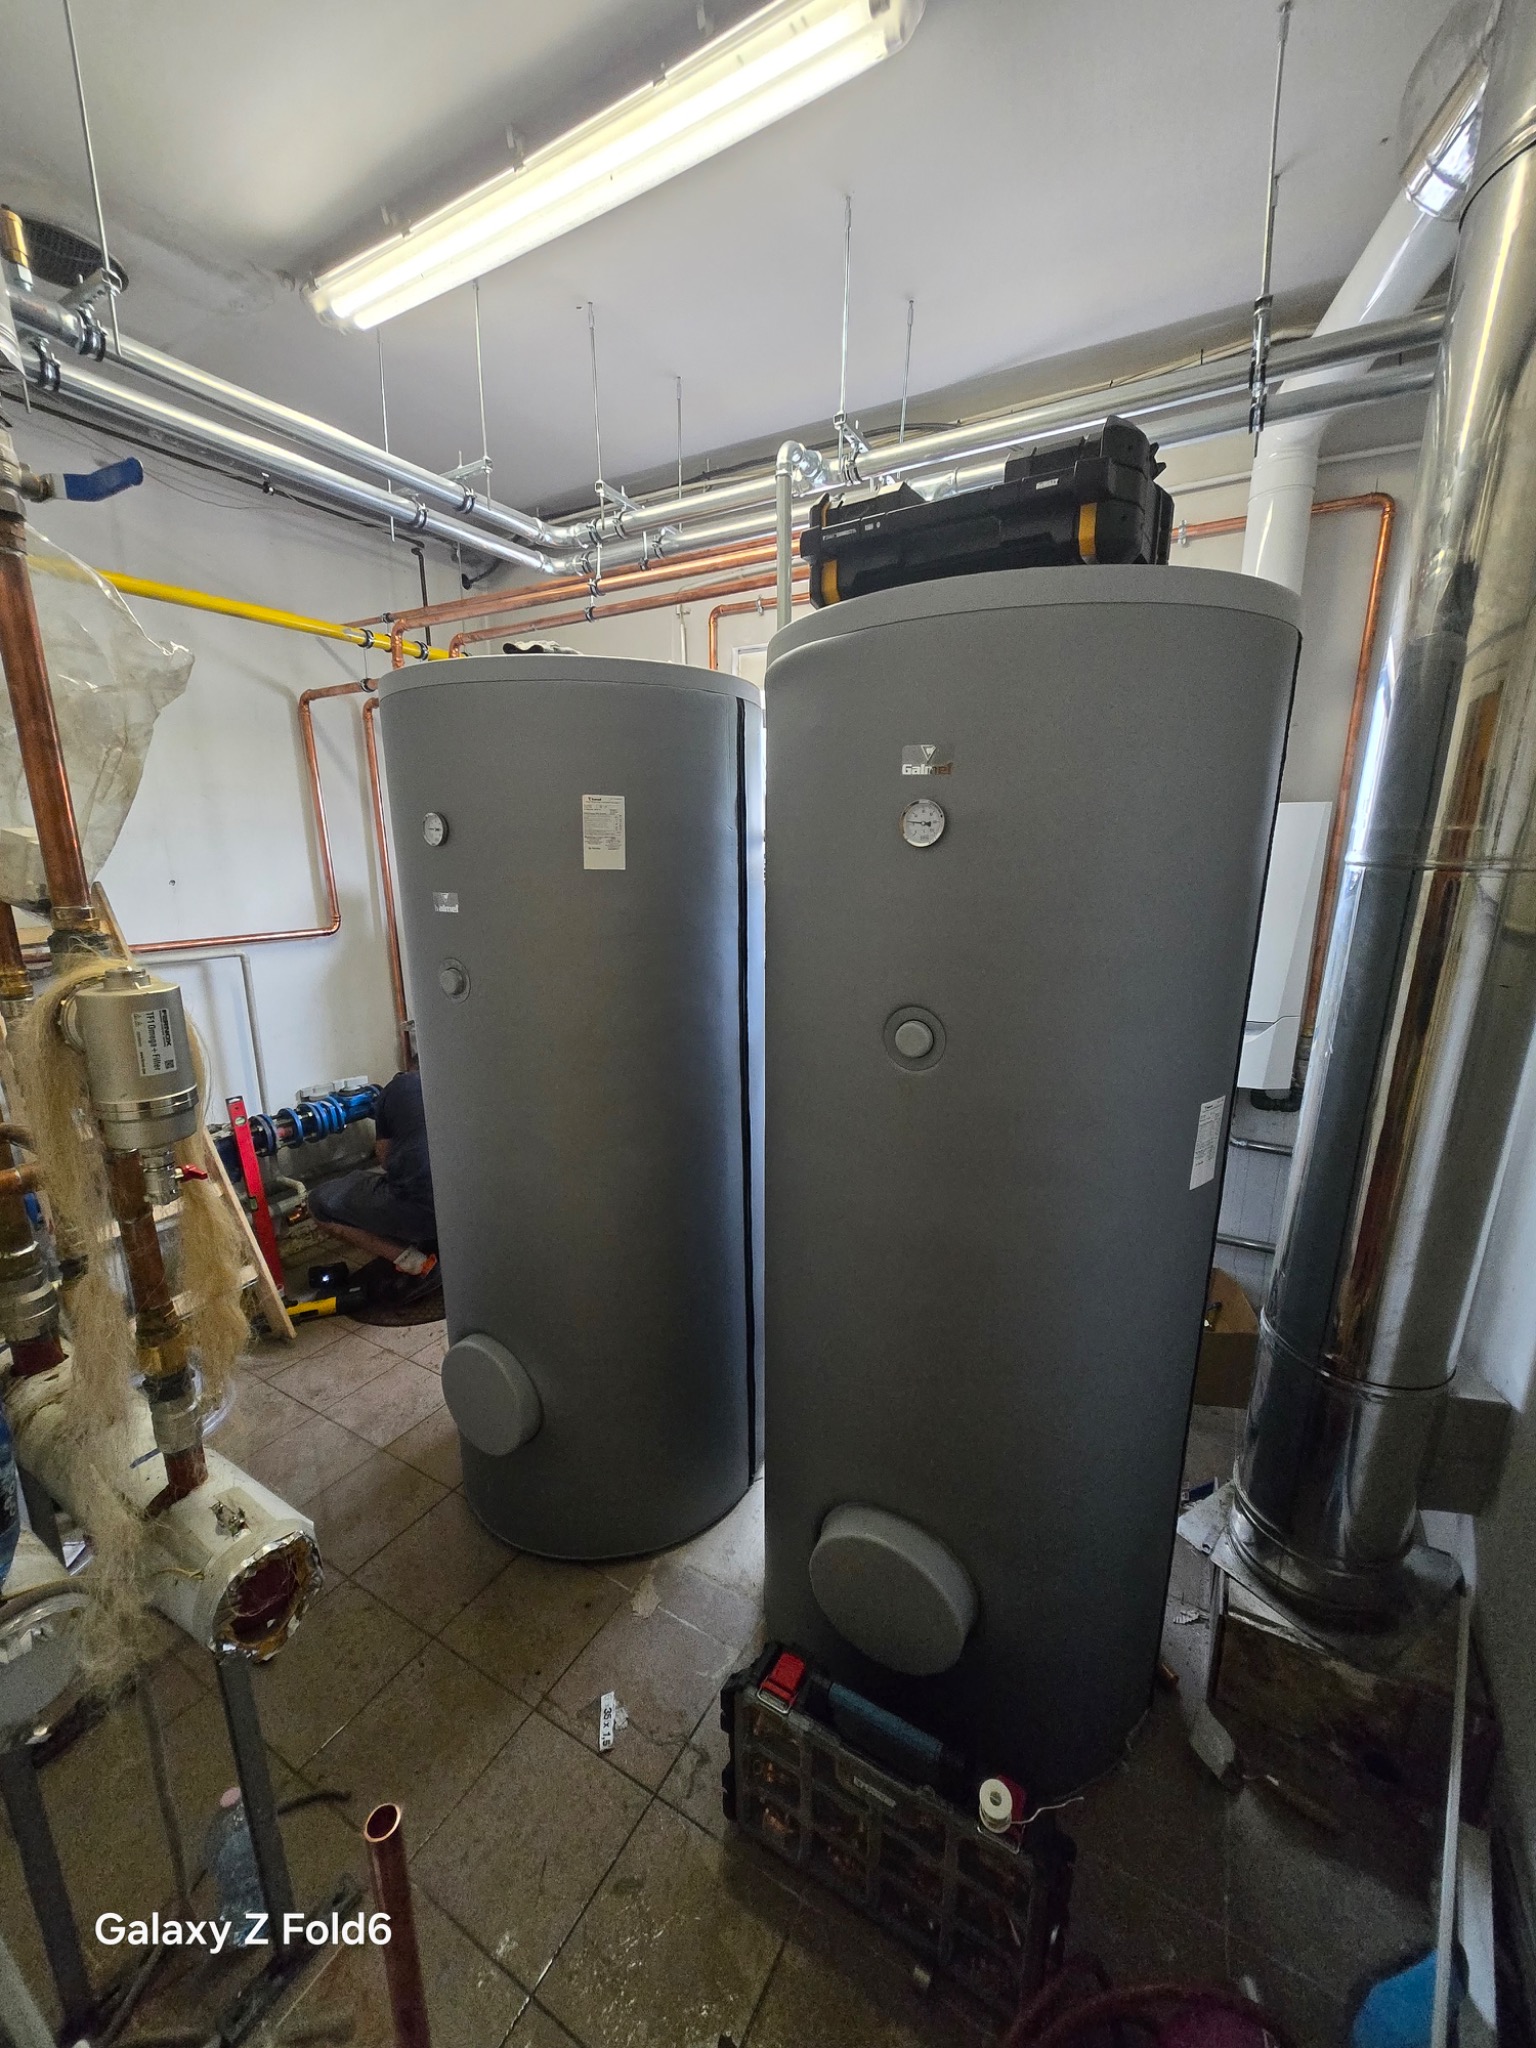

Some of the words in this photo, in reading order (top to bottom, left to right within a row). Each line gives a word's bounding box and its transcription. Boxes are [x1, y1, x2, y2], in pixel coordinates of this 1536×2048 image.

[162, 1009, 172, 1047] FERNOX
[603, 1707, 612, 1720] 35
[601, 1731, 611, 1747] 1,5
